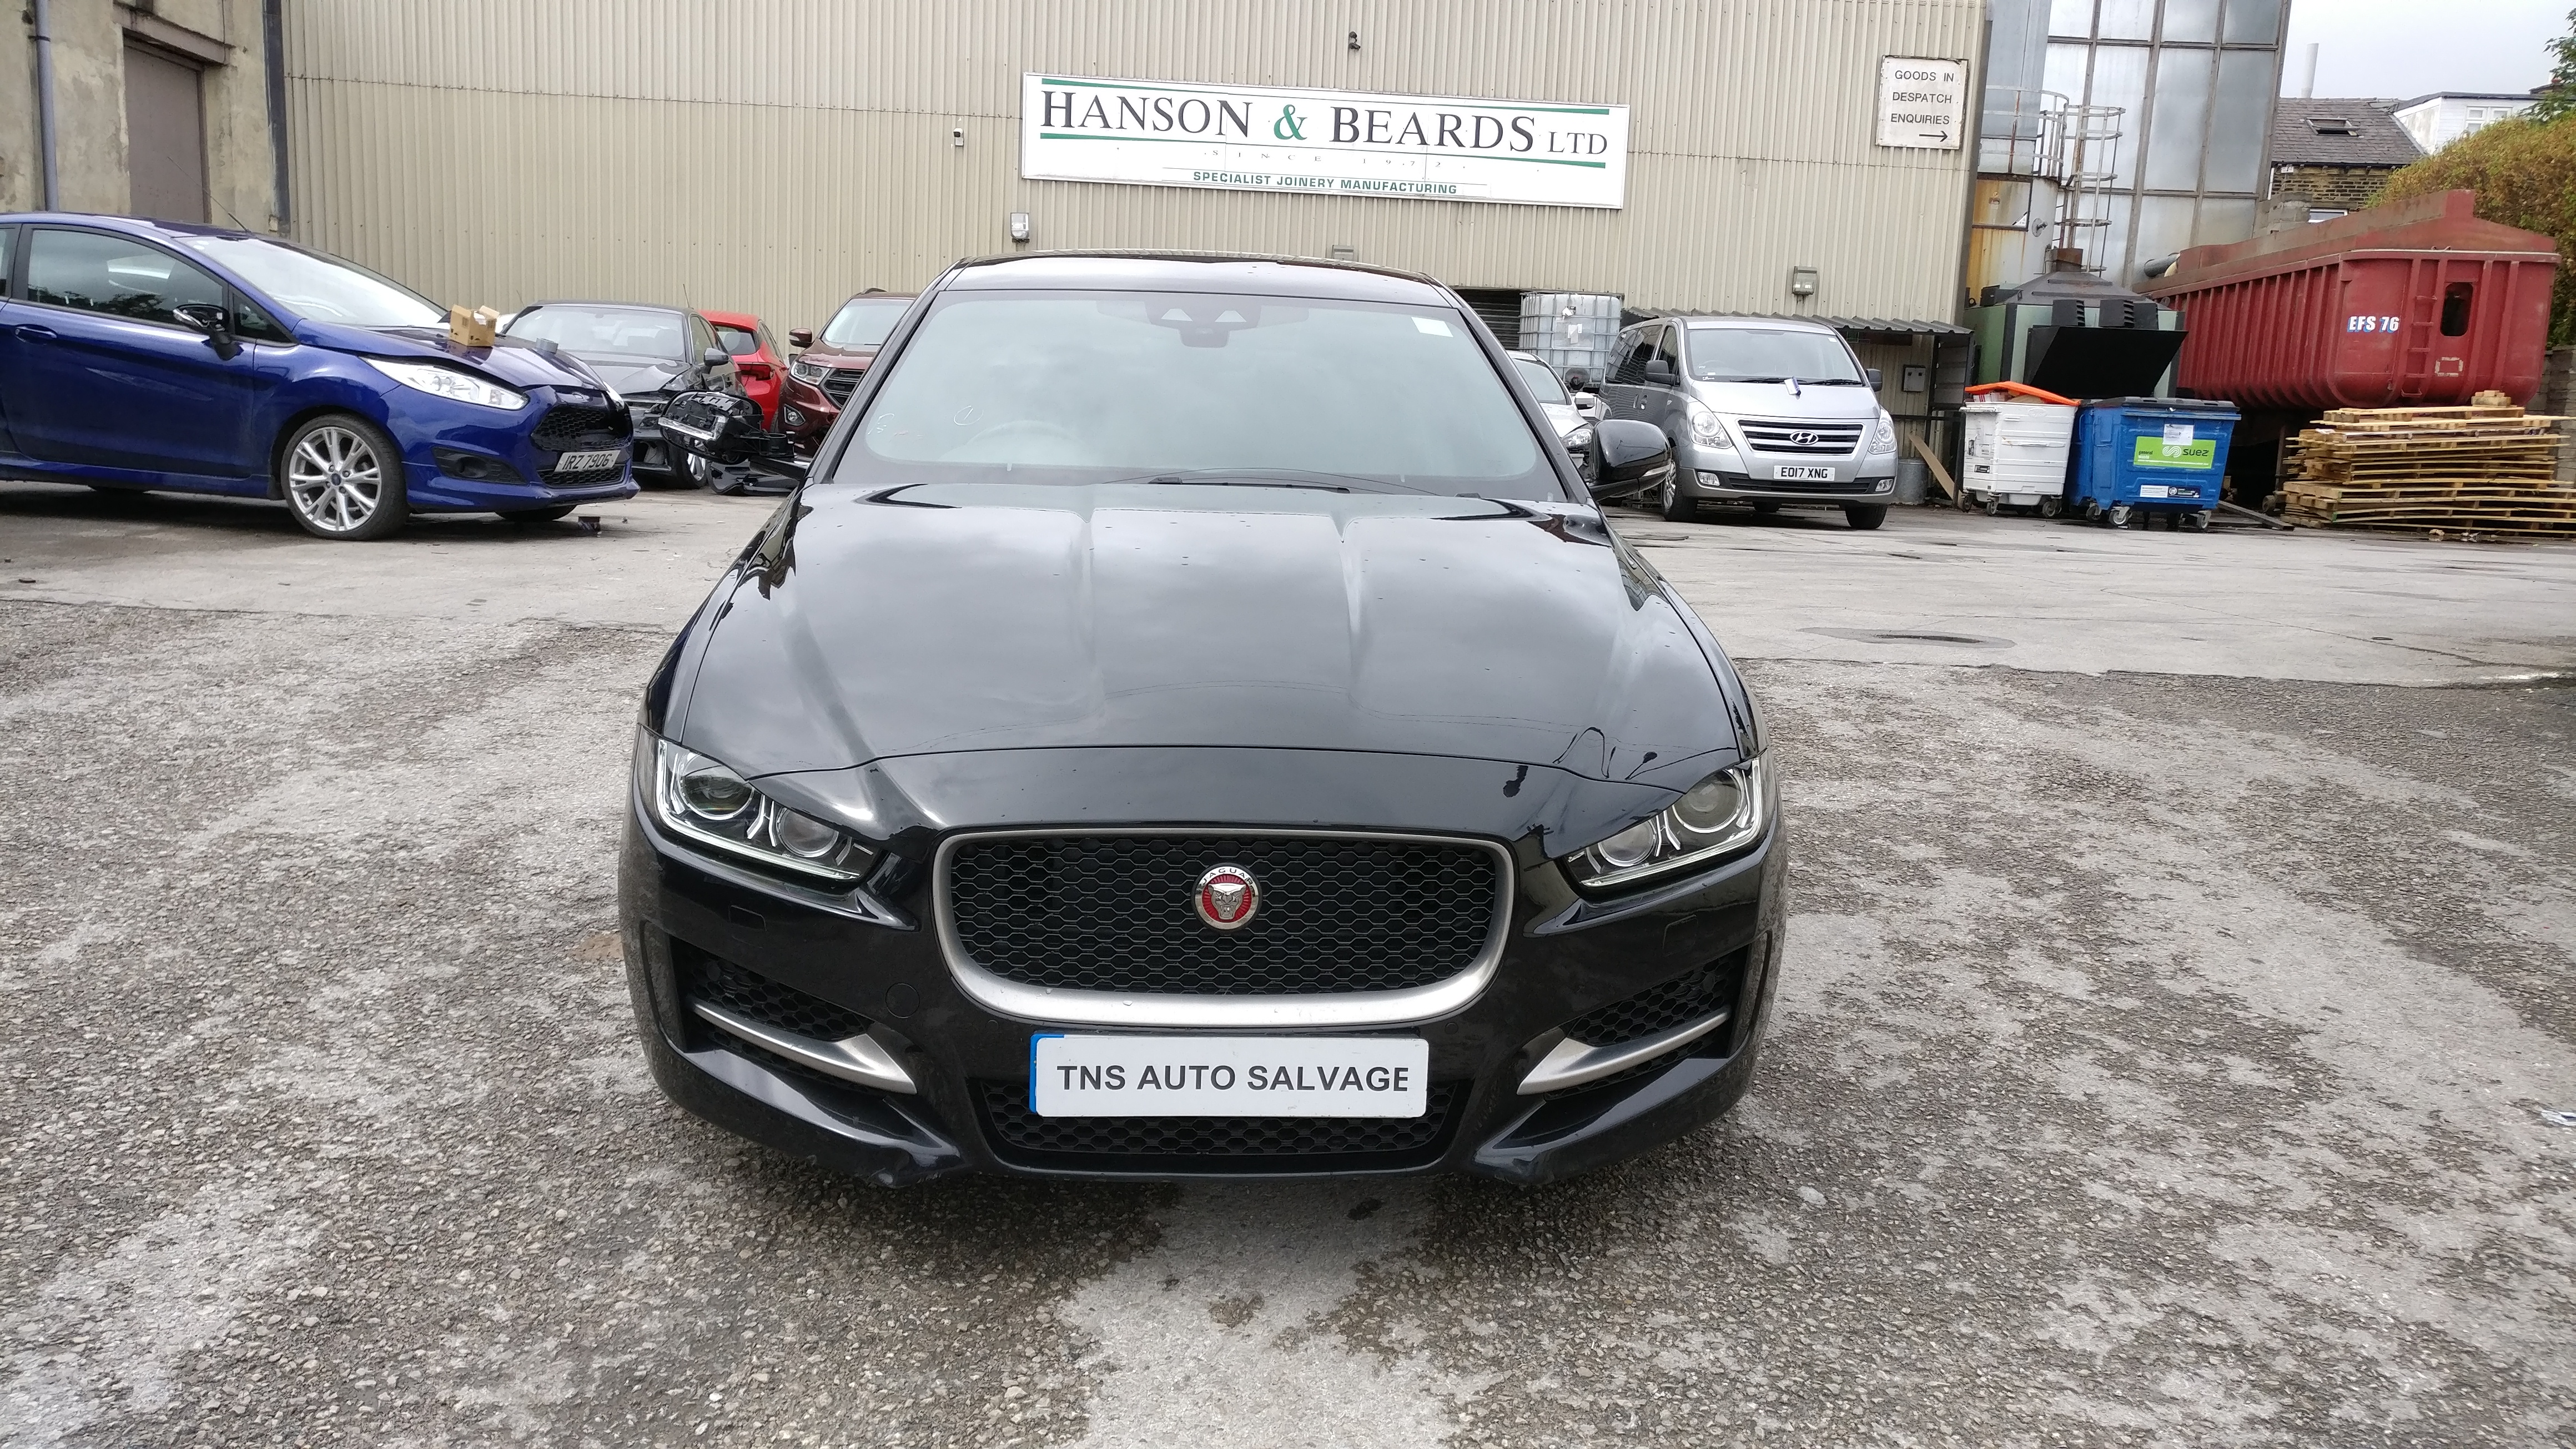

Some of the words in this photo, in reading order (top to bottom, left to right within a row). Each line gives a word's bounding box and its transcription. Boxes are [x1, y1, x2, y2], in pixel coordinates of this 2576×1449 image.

[1895, 70, 1936, 81] GOODS
[1944, 72, 1954, 82] IN
[1892, 92, 1952, 104] DESPATCH
[1040, 90, 1253, 138] HANSON
[1274, 104, 1307, 140] &
[1329, 106, 1534, 152] BEARDS
[1548, 132, 1607, 154] LTD
[1890, 113, 1950, 125] ENQUIRIES
[1212, 149, 1321, 162] SINCE
[1193, 172, 1271, 185] SPECIALIST
[1276, 175, 1335, 188] JOINERY
[1341, 179, 1457, 194] MANUFACTURING
[2348, 316, 2376, 331] EFS
[2379, 316, 2399, 332] 76
[2182, 449, 2209, 457] suez
[583, 453, 613, 469] 7906
[1807, 467, 1828, 479] XNG
[1202, 868, 1254, 886] JAGUAR
[1056, 1065, 1125, 1091] TNS
[1136, 1065, 1236, 1091] AUTO
[1247, 1065, 1408, 1091] SALVAGE
